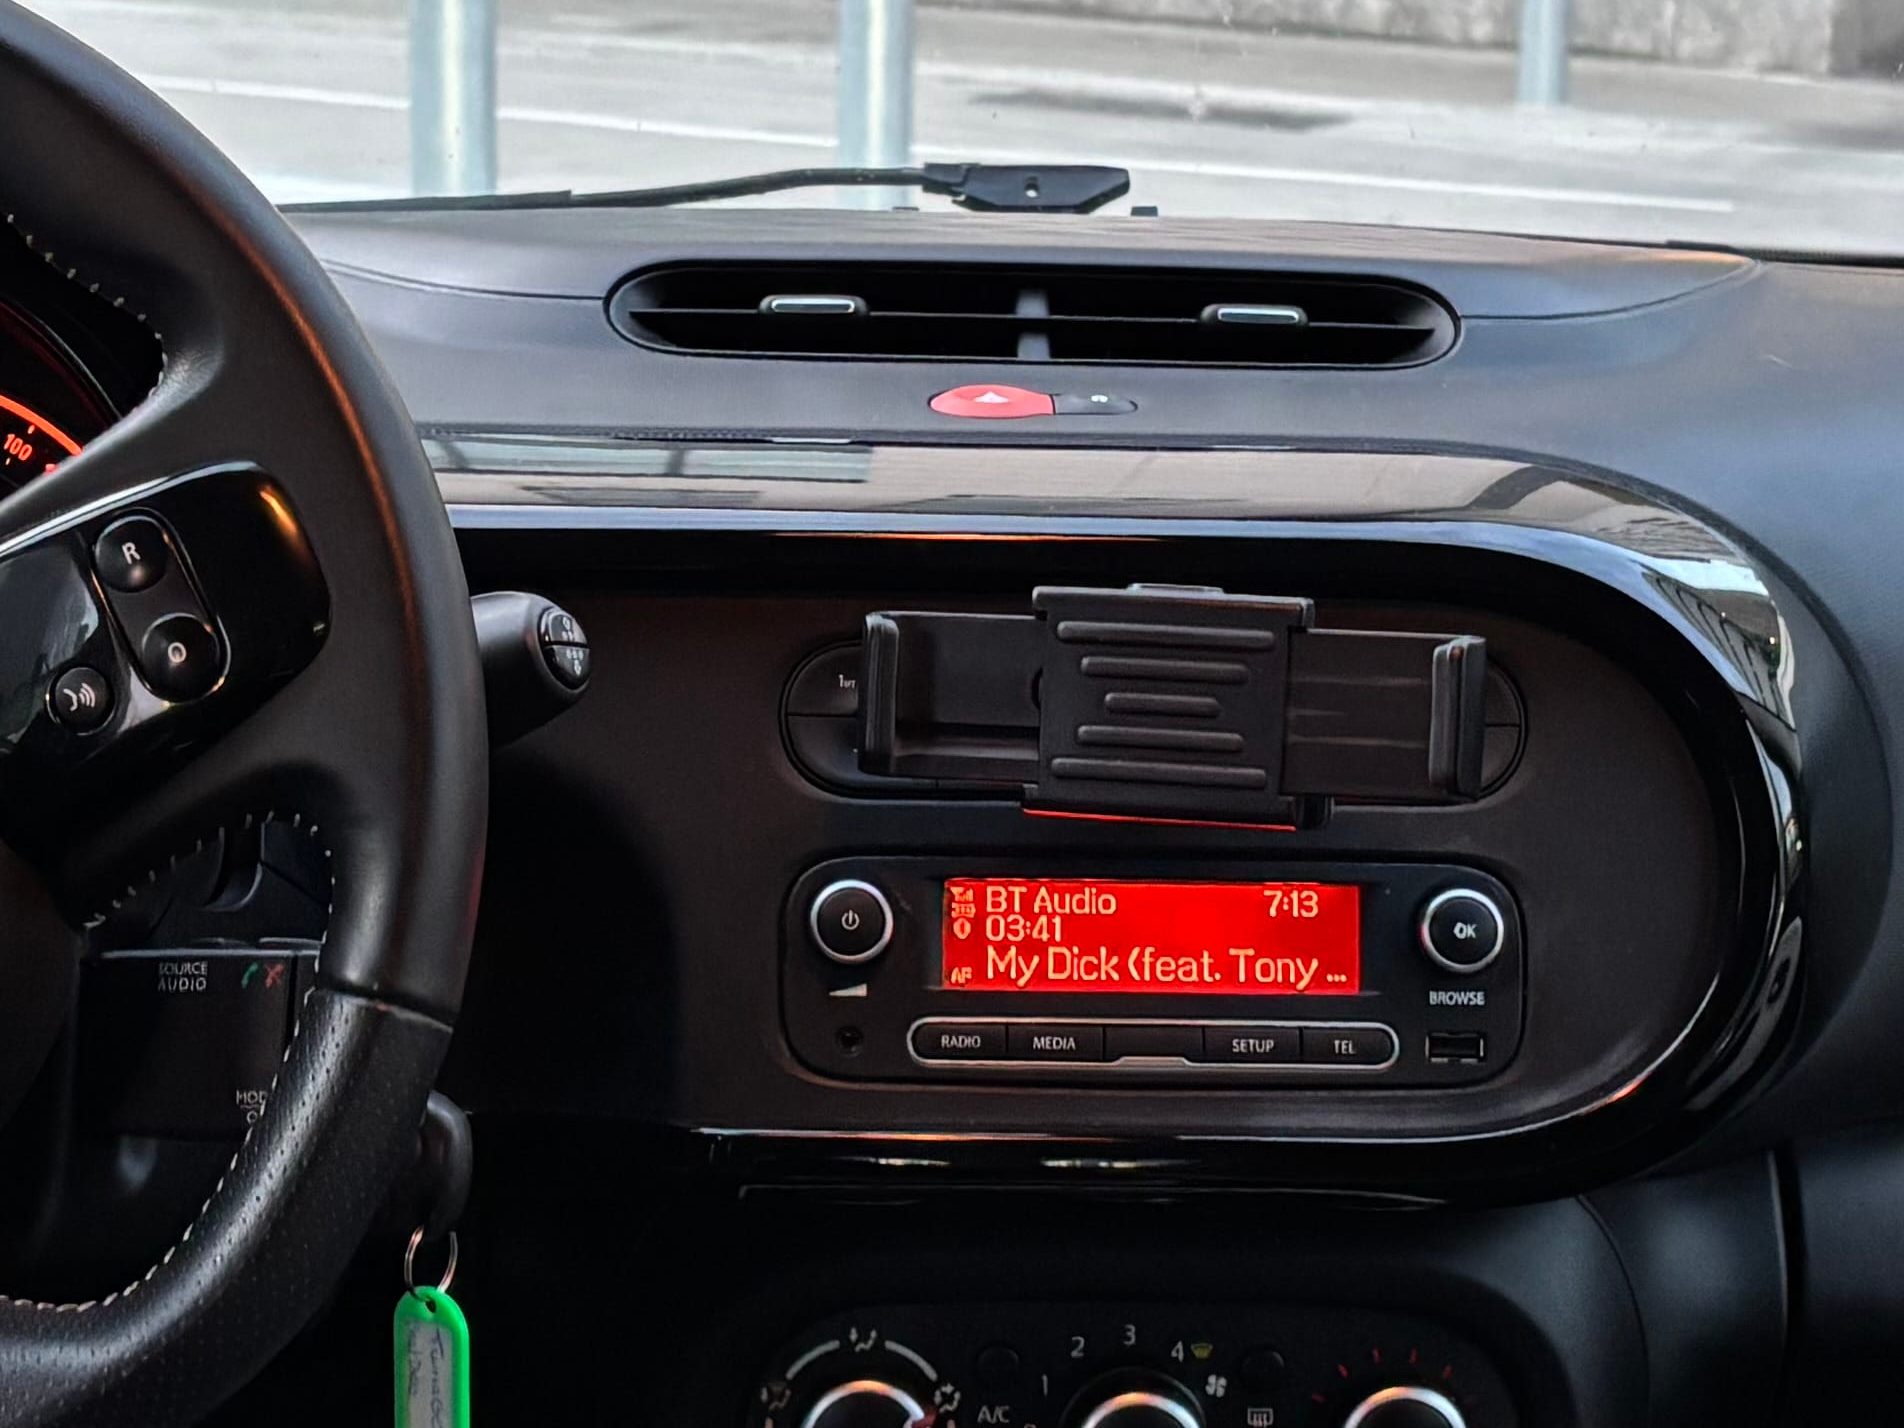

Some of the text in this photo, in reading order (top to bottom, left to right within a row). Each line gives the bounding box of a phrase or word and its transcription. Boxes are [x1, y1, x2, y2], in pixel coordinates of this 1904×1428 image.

[4, 432, 33, 462] 100
[121, 542, 141, 565] R
[986, 887, 1319, 919] BT Audio 7:13
[986, 916, 1062, 942] 03:41
[1452, 922, 1477, 939] OK
[157, 960, 208, 976] SOURCE
[986, 948, 1040, 988] My
[1047, 948, 1121, 982] Dick
[1126, 948, 1223, 985] (feat.
[1229, 950, 1319, 990] Tony
[157, 976, 208, 993] AUDIO
[1428, 989, 1486, 1007] BROWSE
[940, 1033, 1357, 1057] RADIO MEDIA SETUP TEL
[235, 1089, 267, 1106] MOD
[1123, 1324, 1137, 1347] 3
[1070, 1336, 1085, 1359] 2
[1170, 1340, 1185, 1363] 4
[1040, 1373, 1049, 1397] 1
[976, 1405, 1011, 1424] A/C
